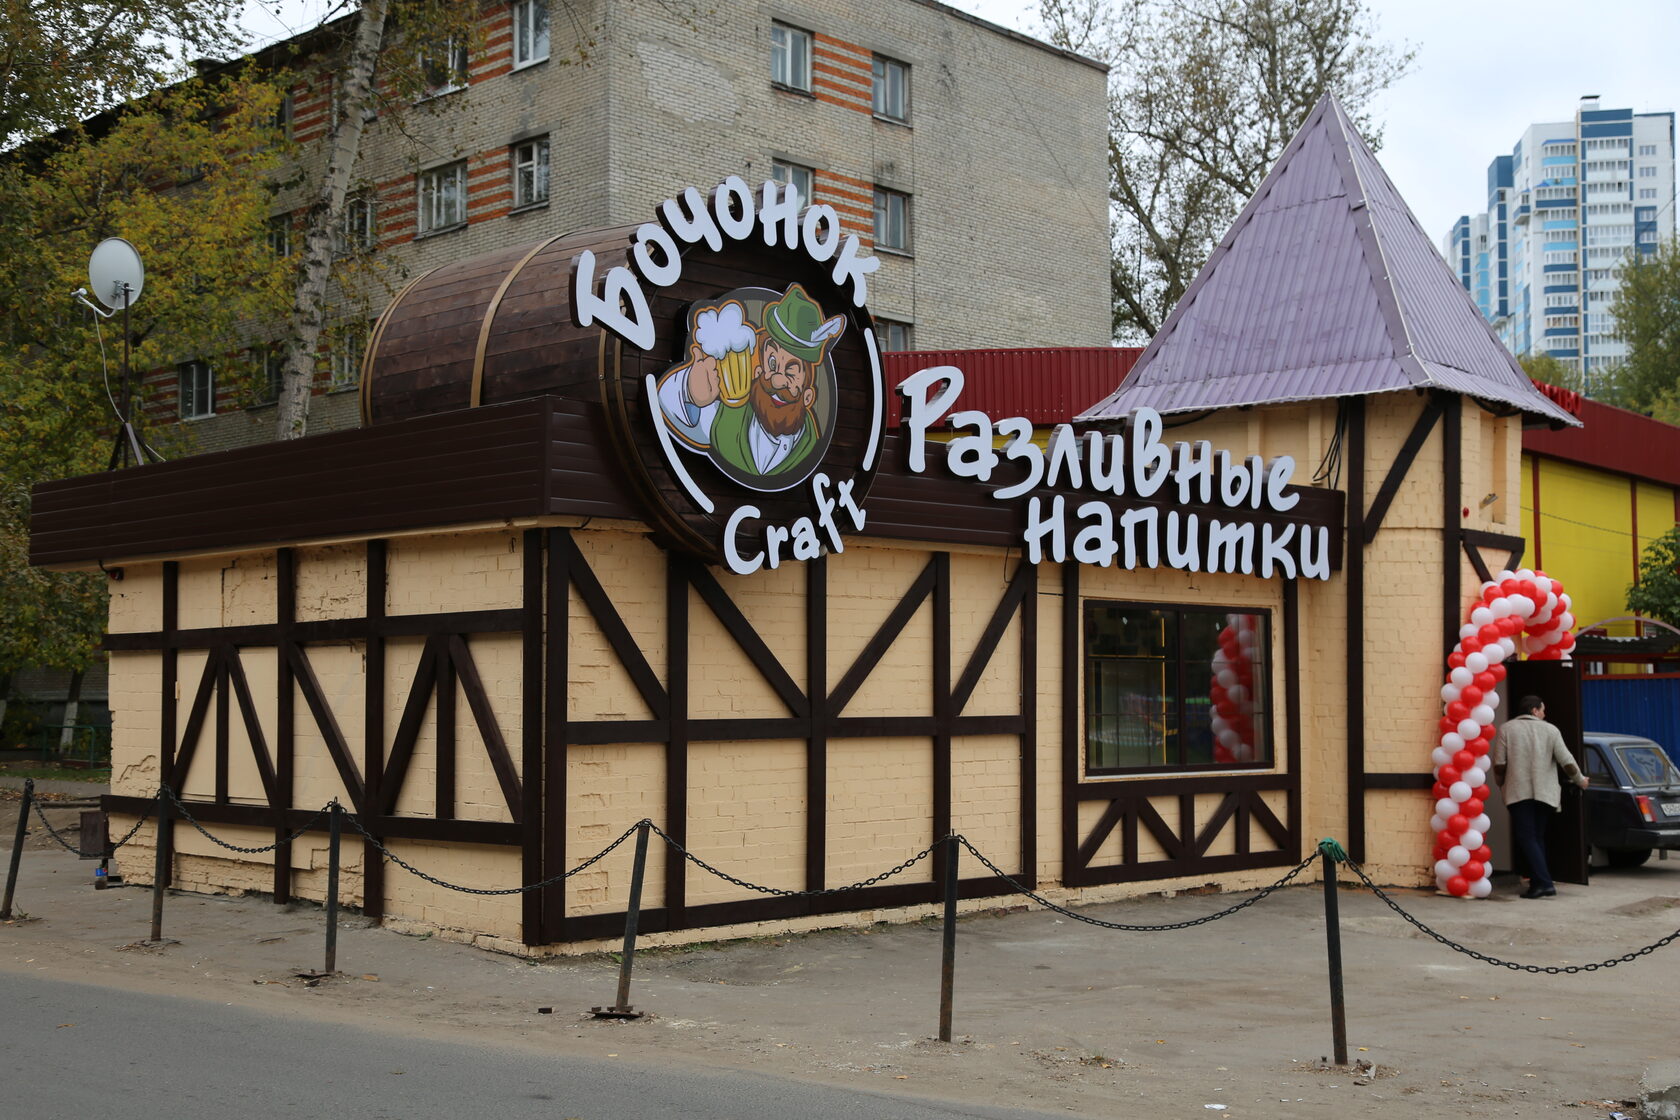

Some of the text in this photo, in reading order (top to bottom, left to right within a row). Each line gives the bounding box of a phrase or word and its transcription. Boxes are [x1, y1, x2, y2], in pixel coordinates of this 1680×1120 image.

[576, 175, 881, 351] Бочонок
[902, 365, 1300, 512] Разливные
[723, 472, 867, 575] Craft
